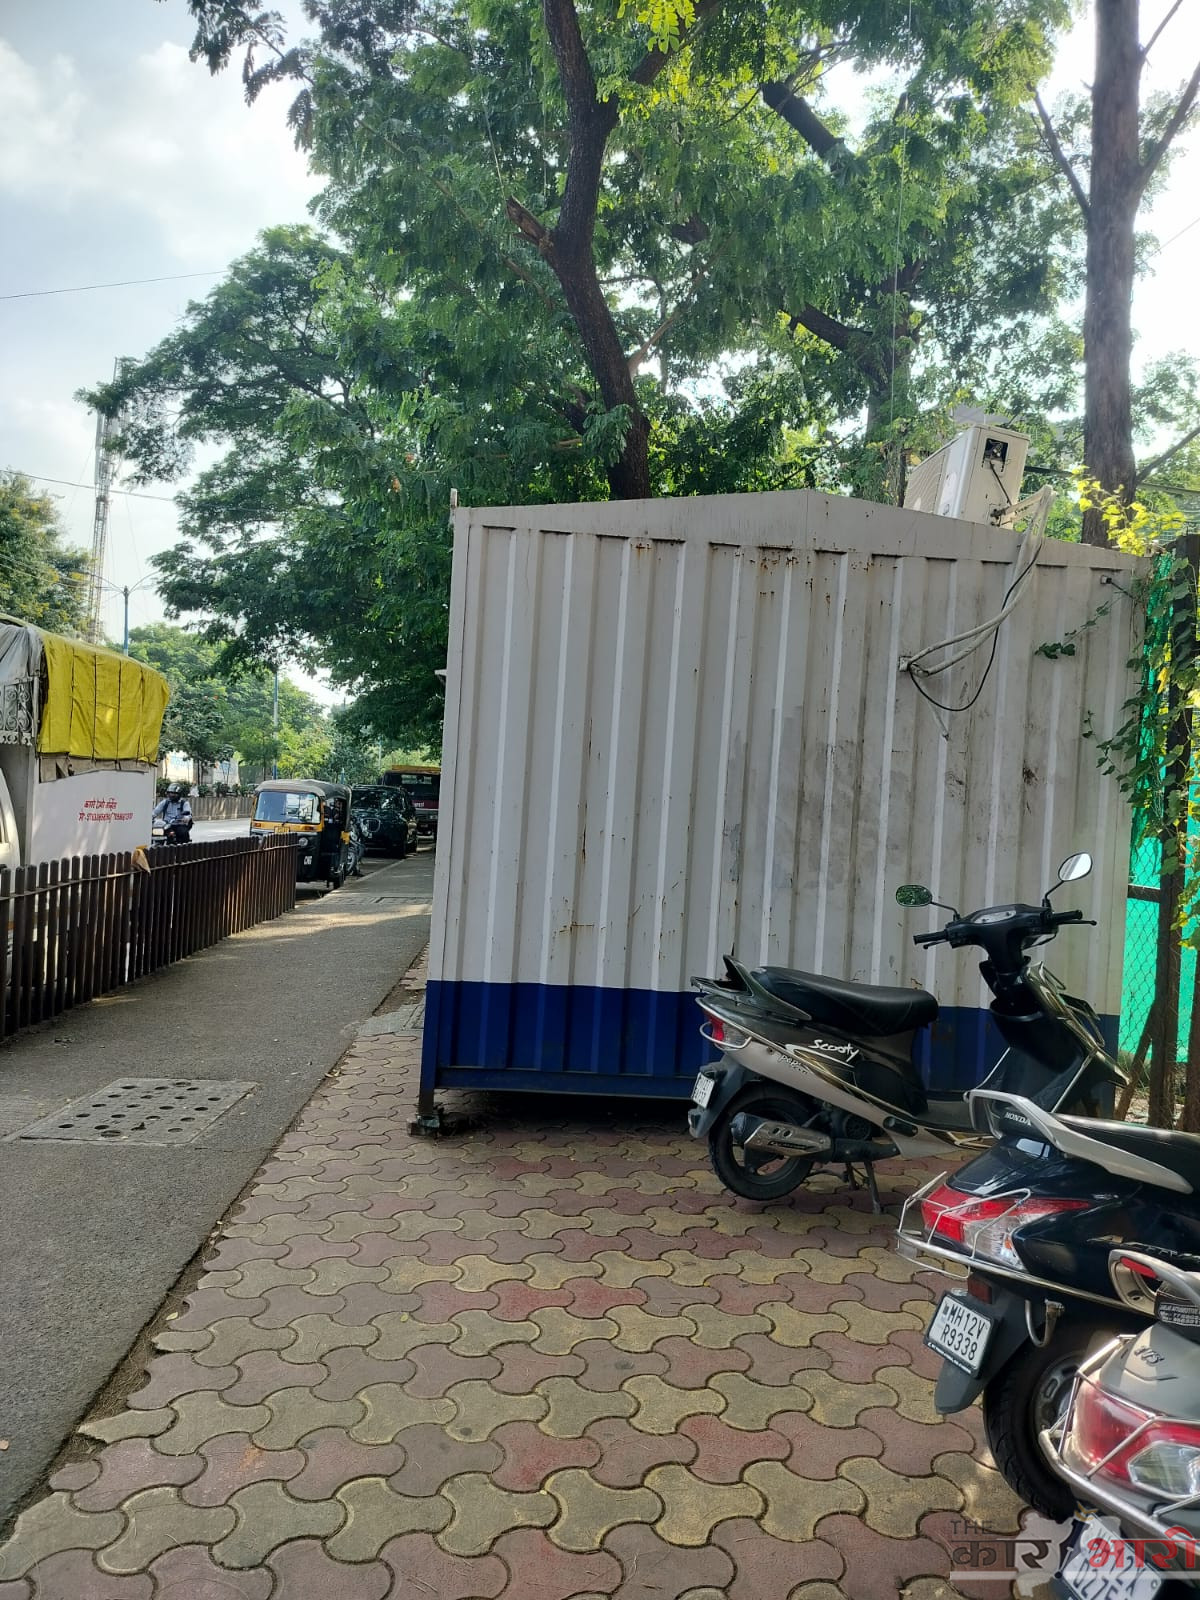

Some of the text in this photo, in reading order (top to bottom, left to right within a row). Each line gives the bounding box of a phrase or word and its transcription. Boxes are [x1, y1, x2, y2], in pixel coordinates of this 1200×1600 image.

[808, 1039, 859, 1063] Scooty
[1003, 1111, 1032, 1127] HONDA
[947, 1303, 986, 1340] MH12V
[940, 1323, 978, 1361] R9338
